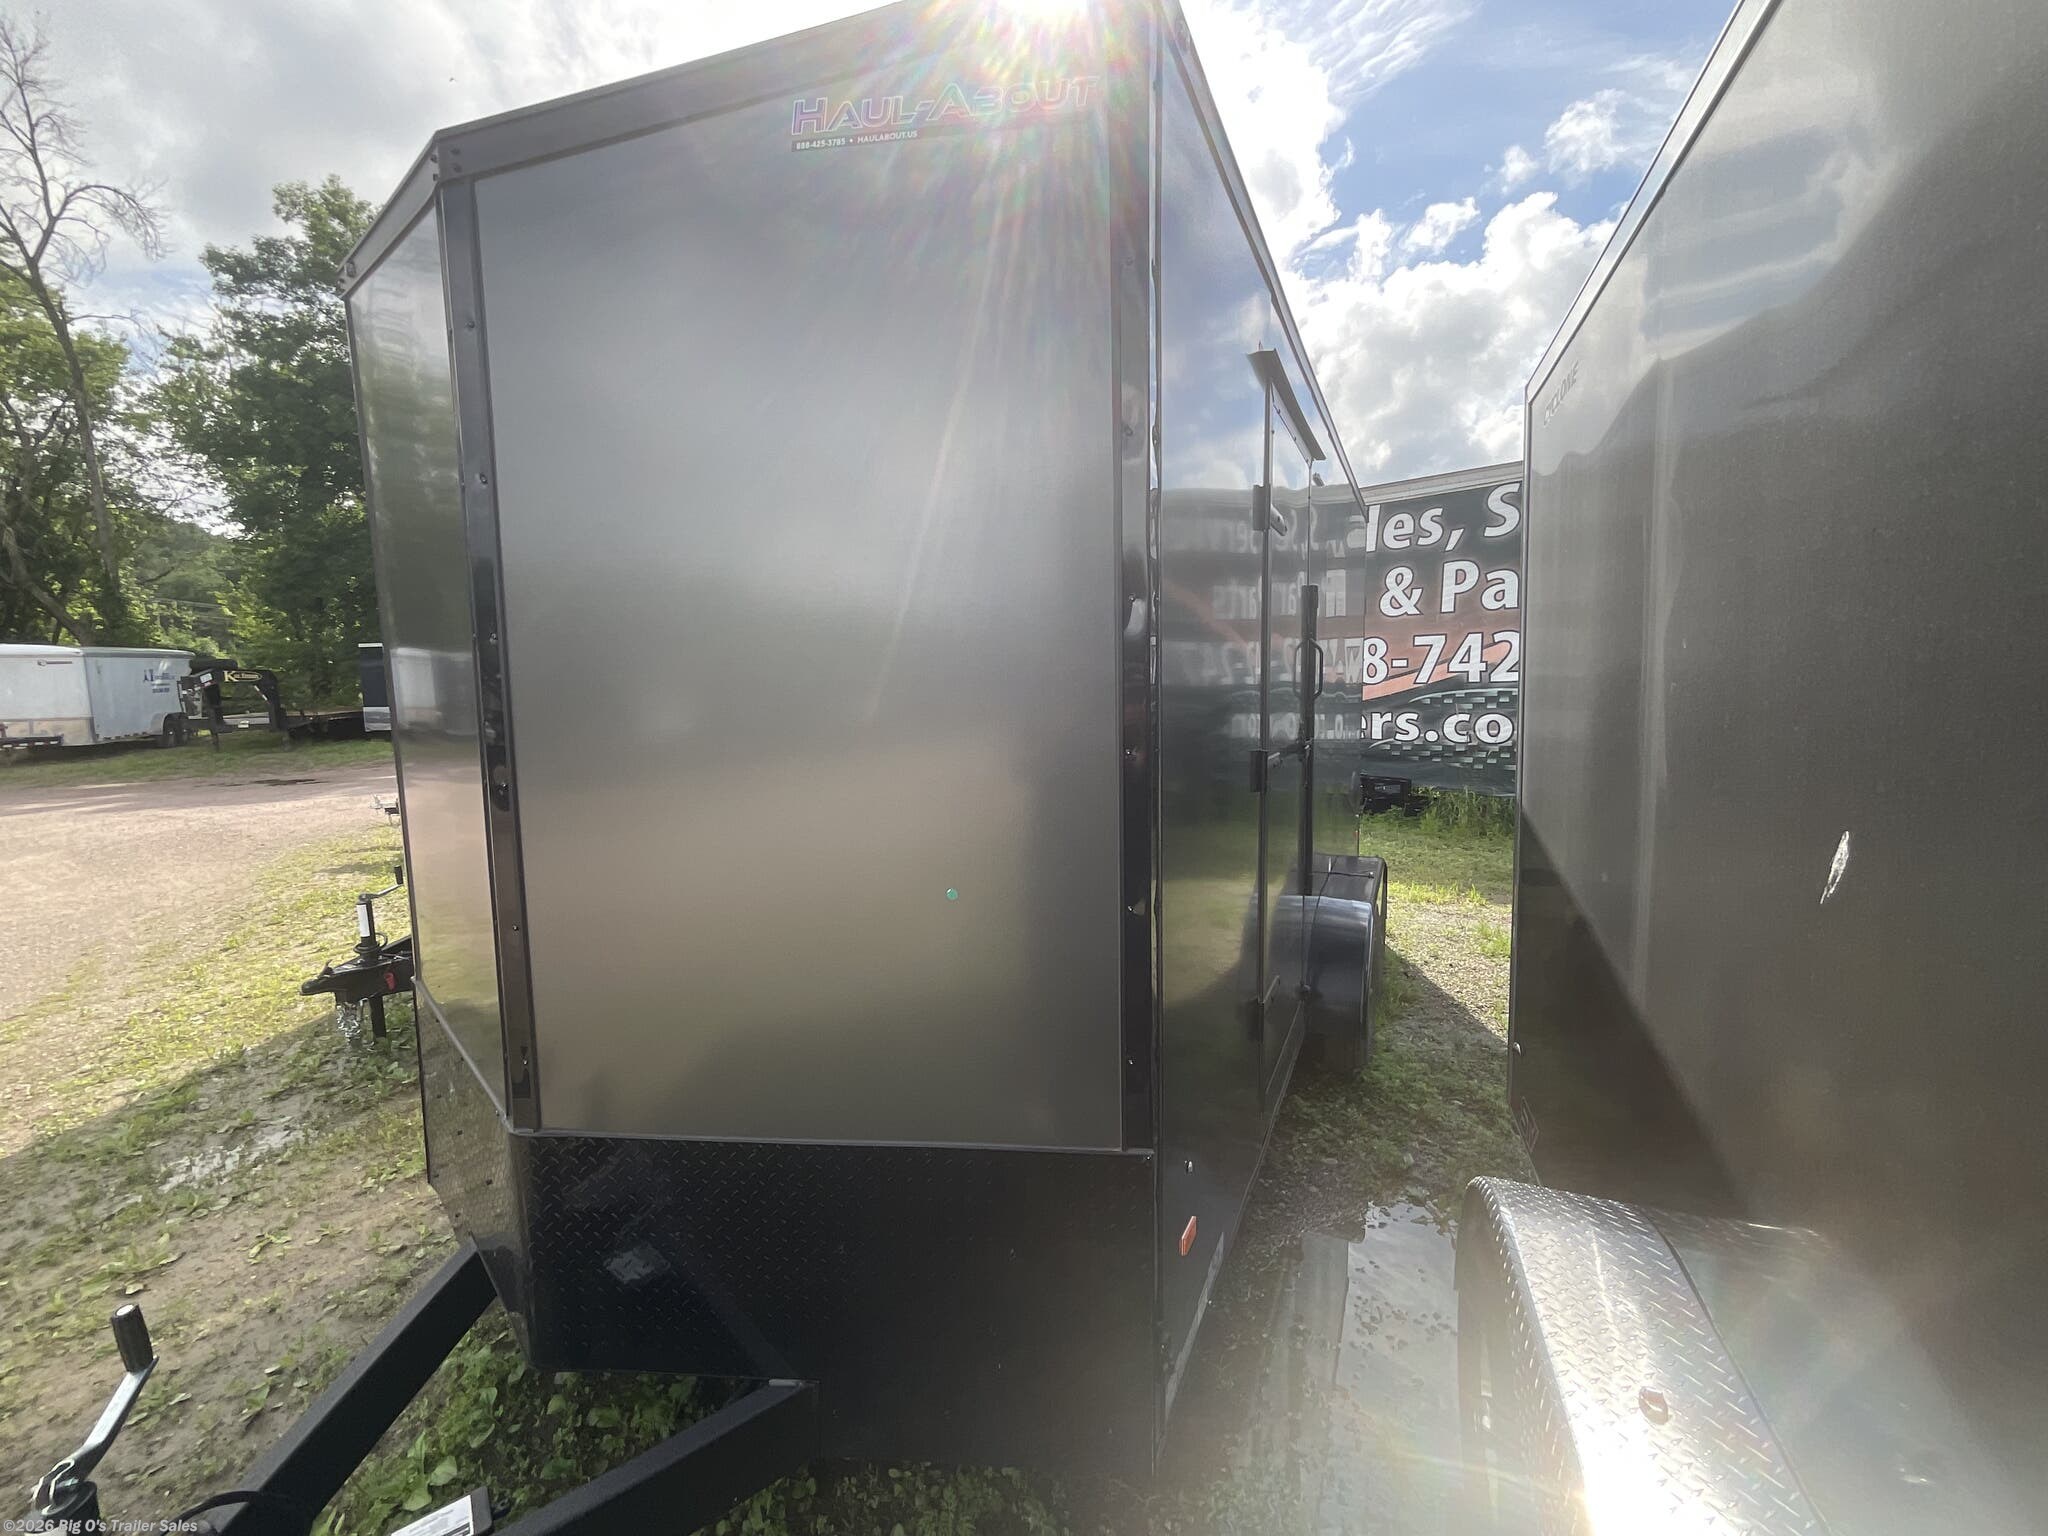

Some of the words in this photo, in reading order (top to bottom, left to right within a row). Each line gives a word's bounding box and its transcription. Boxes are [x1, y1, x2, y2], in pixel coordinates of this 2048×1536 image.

[1379, 565, 1424, 617] &
[1440, 559, 1519, 614] Pa
[1362, 630, 1520, 685] 8-742
